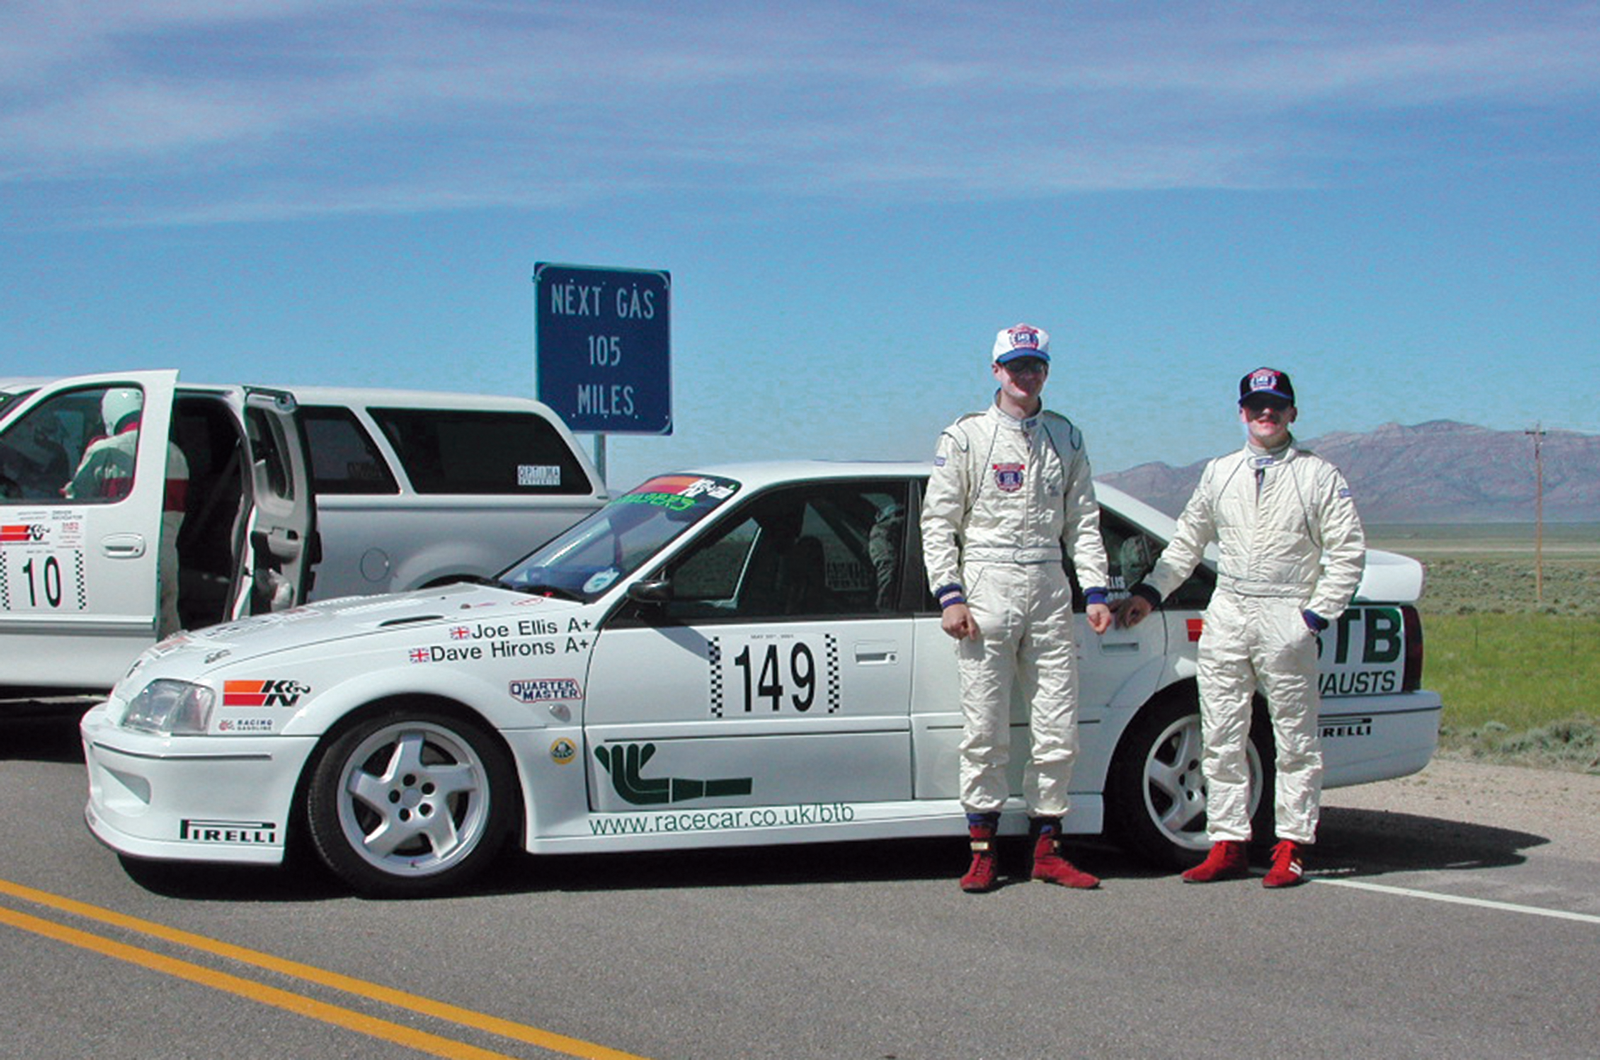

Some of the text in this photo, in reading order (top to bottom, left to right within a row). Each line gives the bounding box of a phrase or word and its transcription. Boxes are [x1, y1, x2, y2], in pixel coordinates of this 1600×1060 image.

[551, 284, 655, 319] NEXT GAS
[588, 335, 621, 366] 105
[577, 384, 634, 415] MILES
[23, 556, 61, 607] 10
[472, 617, 591, 639] Joe Ellis A+
[1316, 608, 1402, 664] TB
[430, 637, 589, 662] Dave Hirons A+
[511, 682, 574, 695] QUARTER
[735, 642, 815, 712] 149
[1319, 670, 1395, 695] AUSTS
[261, 680, 311, 706] K&N
[523, 690, 578, 701] MASTER
[180, 819, 276, 842] PIRELLI
[589, 803, 854, 835] www.racecar.co.uk/btb
